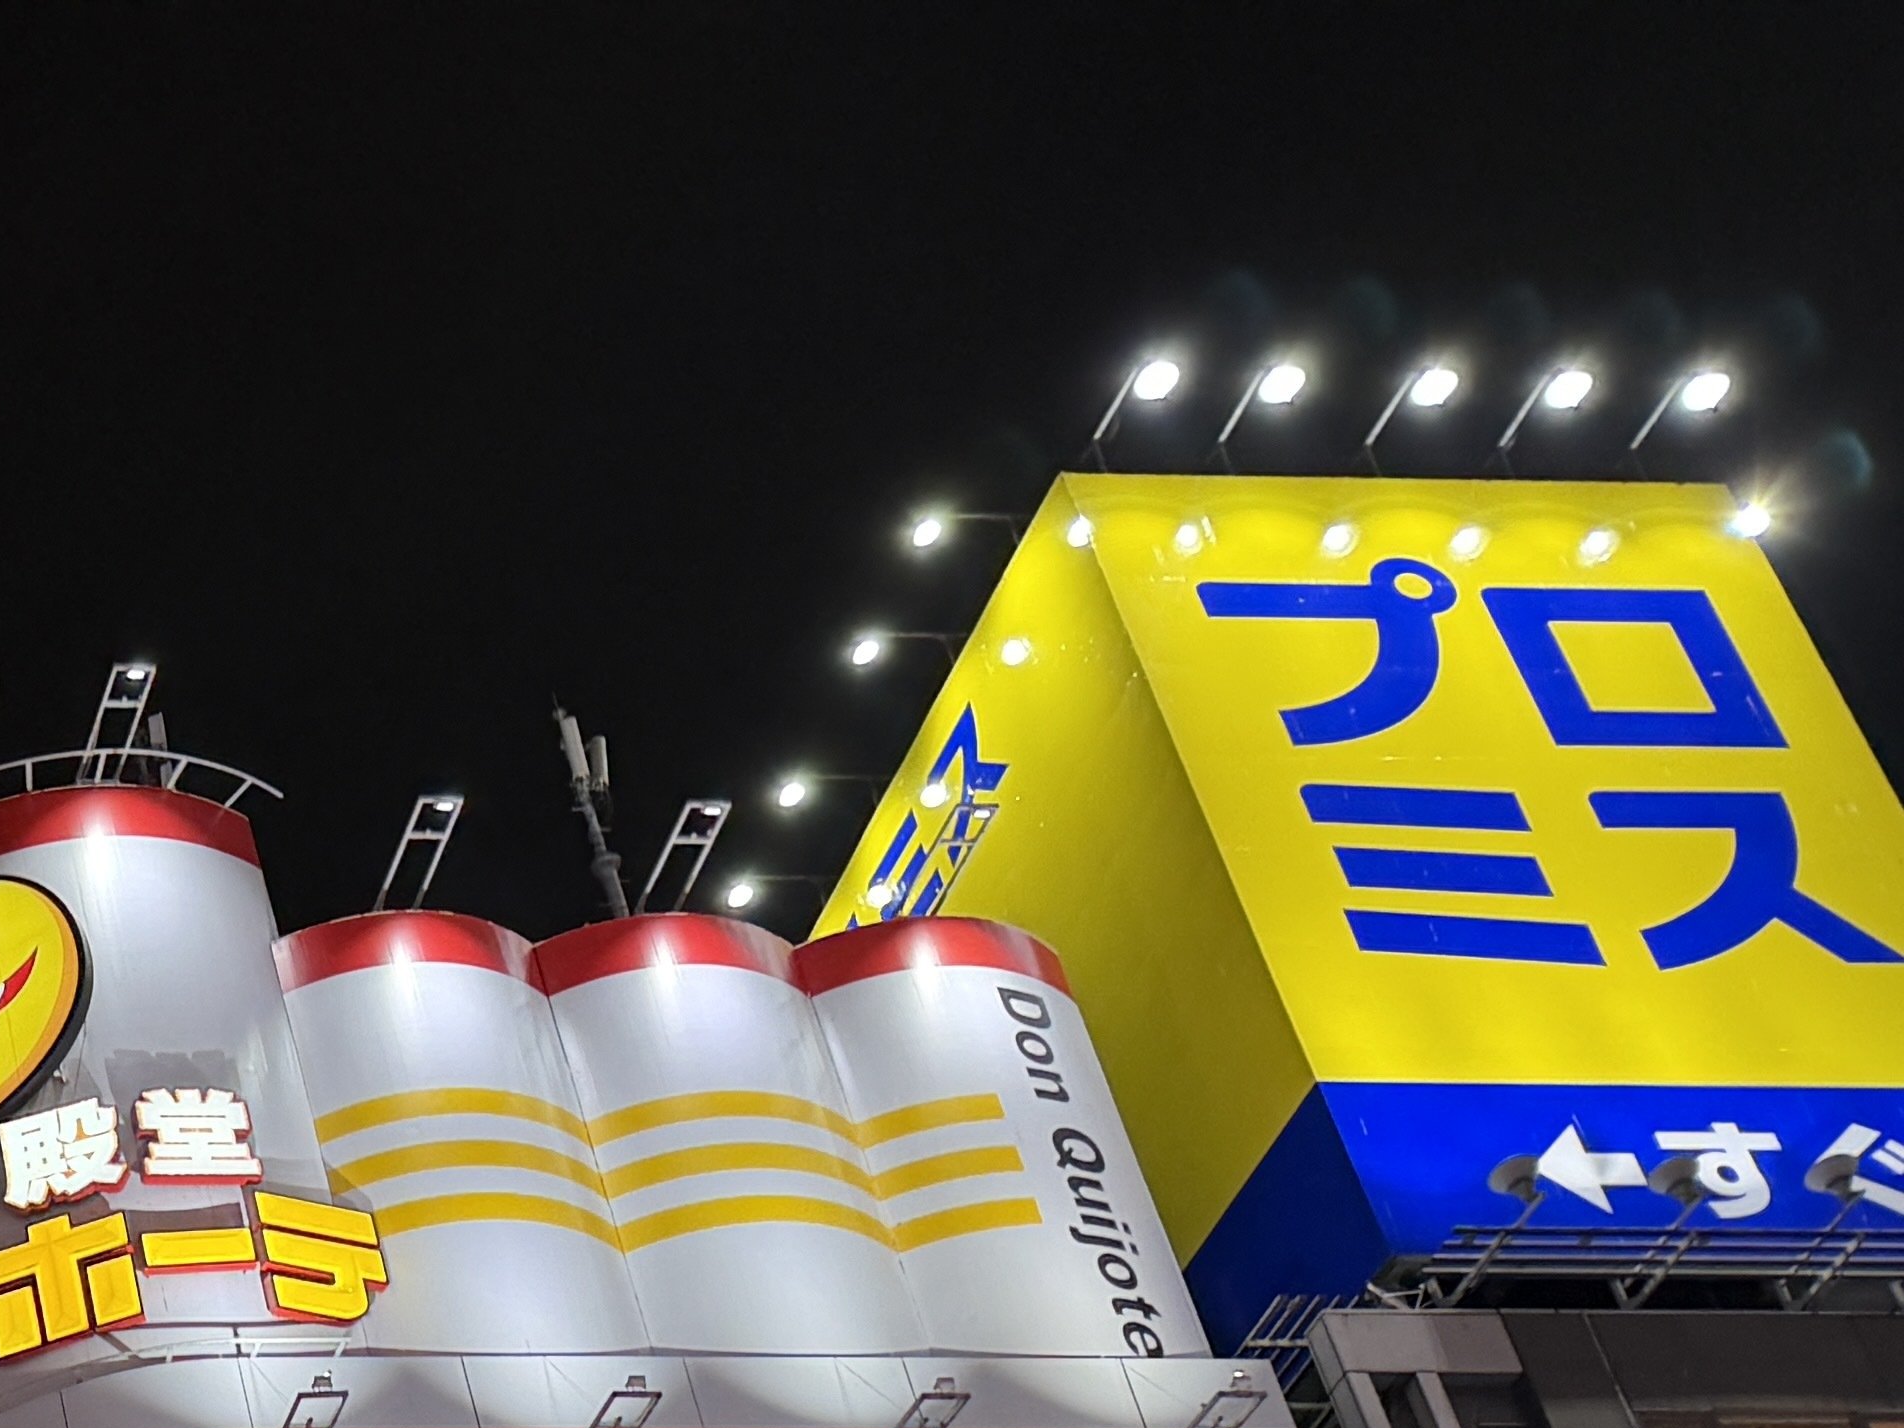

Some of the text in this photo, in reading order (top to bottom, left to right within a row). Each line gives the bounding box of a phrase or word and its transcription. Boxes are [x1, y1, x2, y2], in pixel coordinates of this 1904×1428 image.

[1196, 558, 1789, 748] プロ
[1300, 783, 1904, 970] ミス
[997, 985, 1166, 1358] Don Quijote
